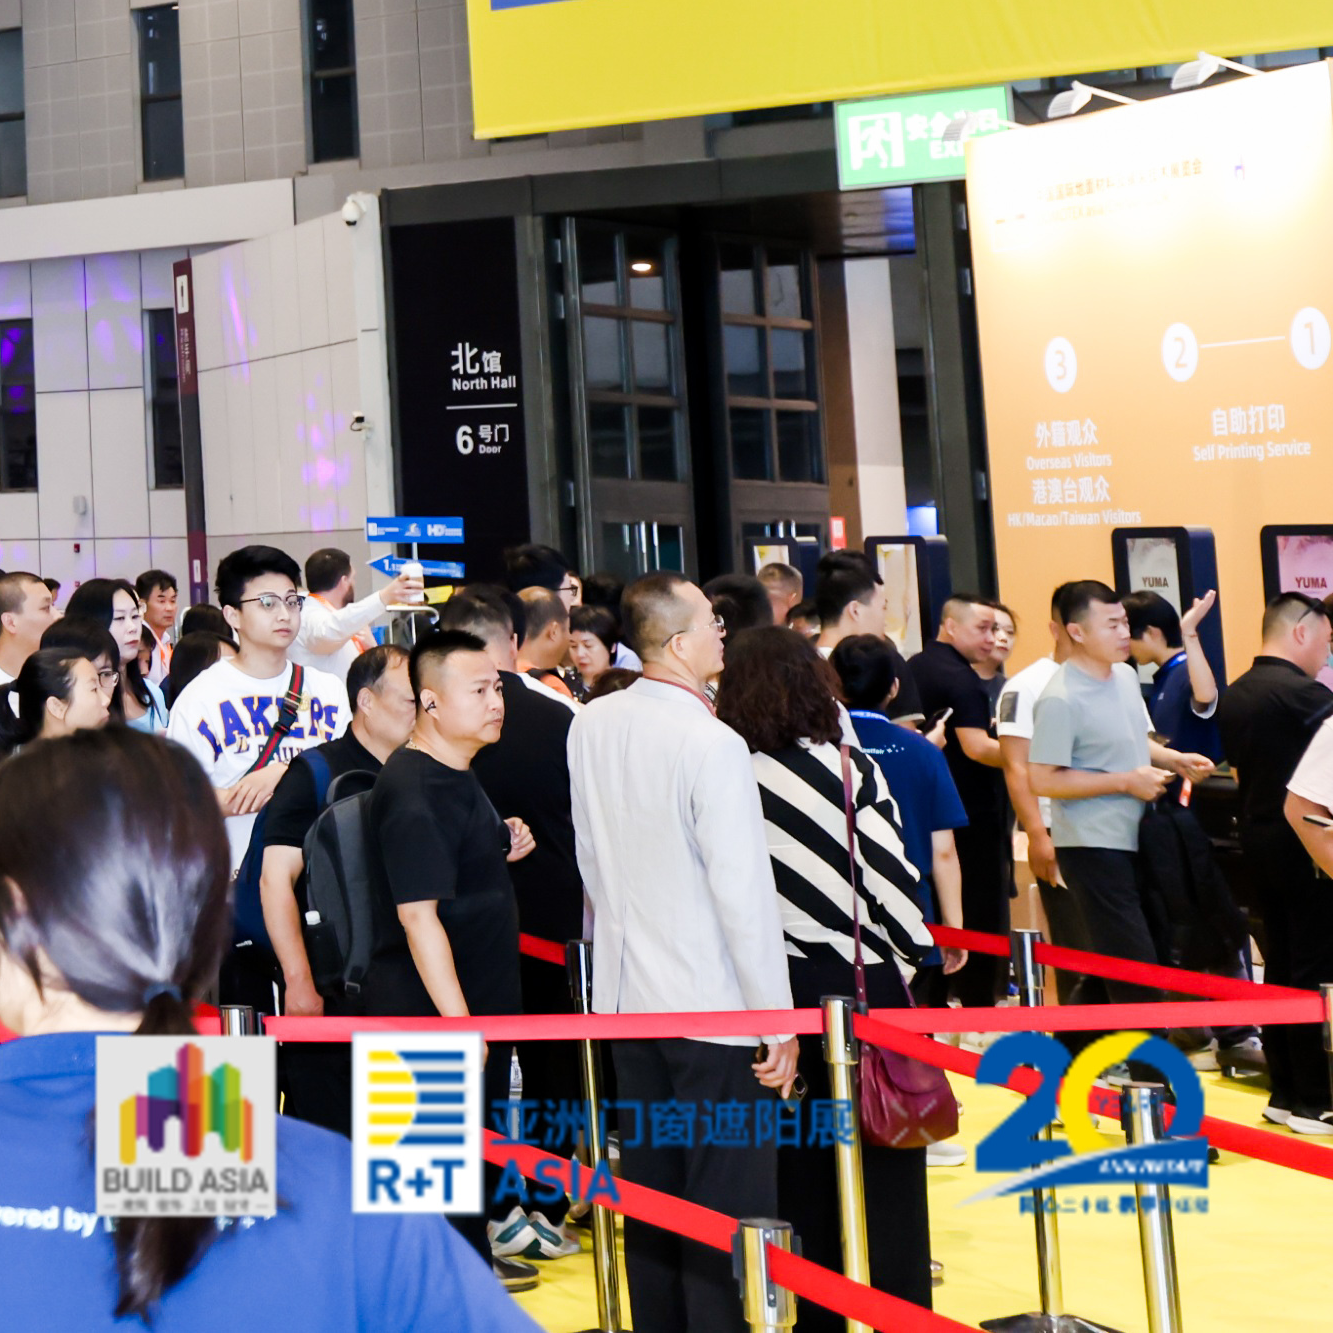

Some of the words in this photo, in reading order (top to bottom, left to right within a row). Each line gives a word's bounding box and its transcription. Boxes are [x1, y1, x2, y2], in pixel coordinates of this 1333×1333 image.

[451, 342, 502, 376] 北馆
[452, 376, 488, 392] North
[490, 374, 517, 390] Hall
[1211, 404, 1286, 437] 自助打印
[455, 425, 474, 455] 6
[478, 424, 510, 444] 号门
[1035, 418, 1099, 449] 外籍观众
[479, 443, 502, 455] Door
[1193, 444, 1215, 462] Self
[1217, 441, 1265, 463] Printing
[1266, 440, 1312, 457] Service
[1026, 453, 1072, 471] Overseas
[1074, 450, 1112, 469] Visitors
[1031, 474, 1111, 506] 港澳台观众
[1007, 510, 1100, 528] HK/Macao/Taiwan
[1102, 508, 1142, 525] Visitors
[1141, 576, 1169, 589] YUMA
[1295, 576, 1328, 589] YUMA
[63, 1206, 98, 1239] by
